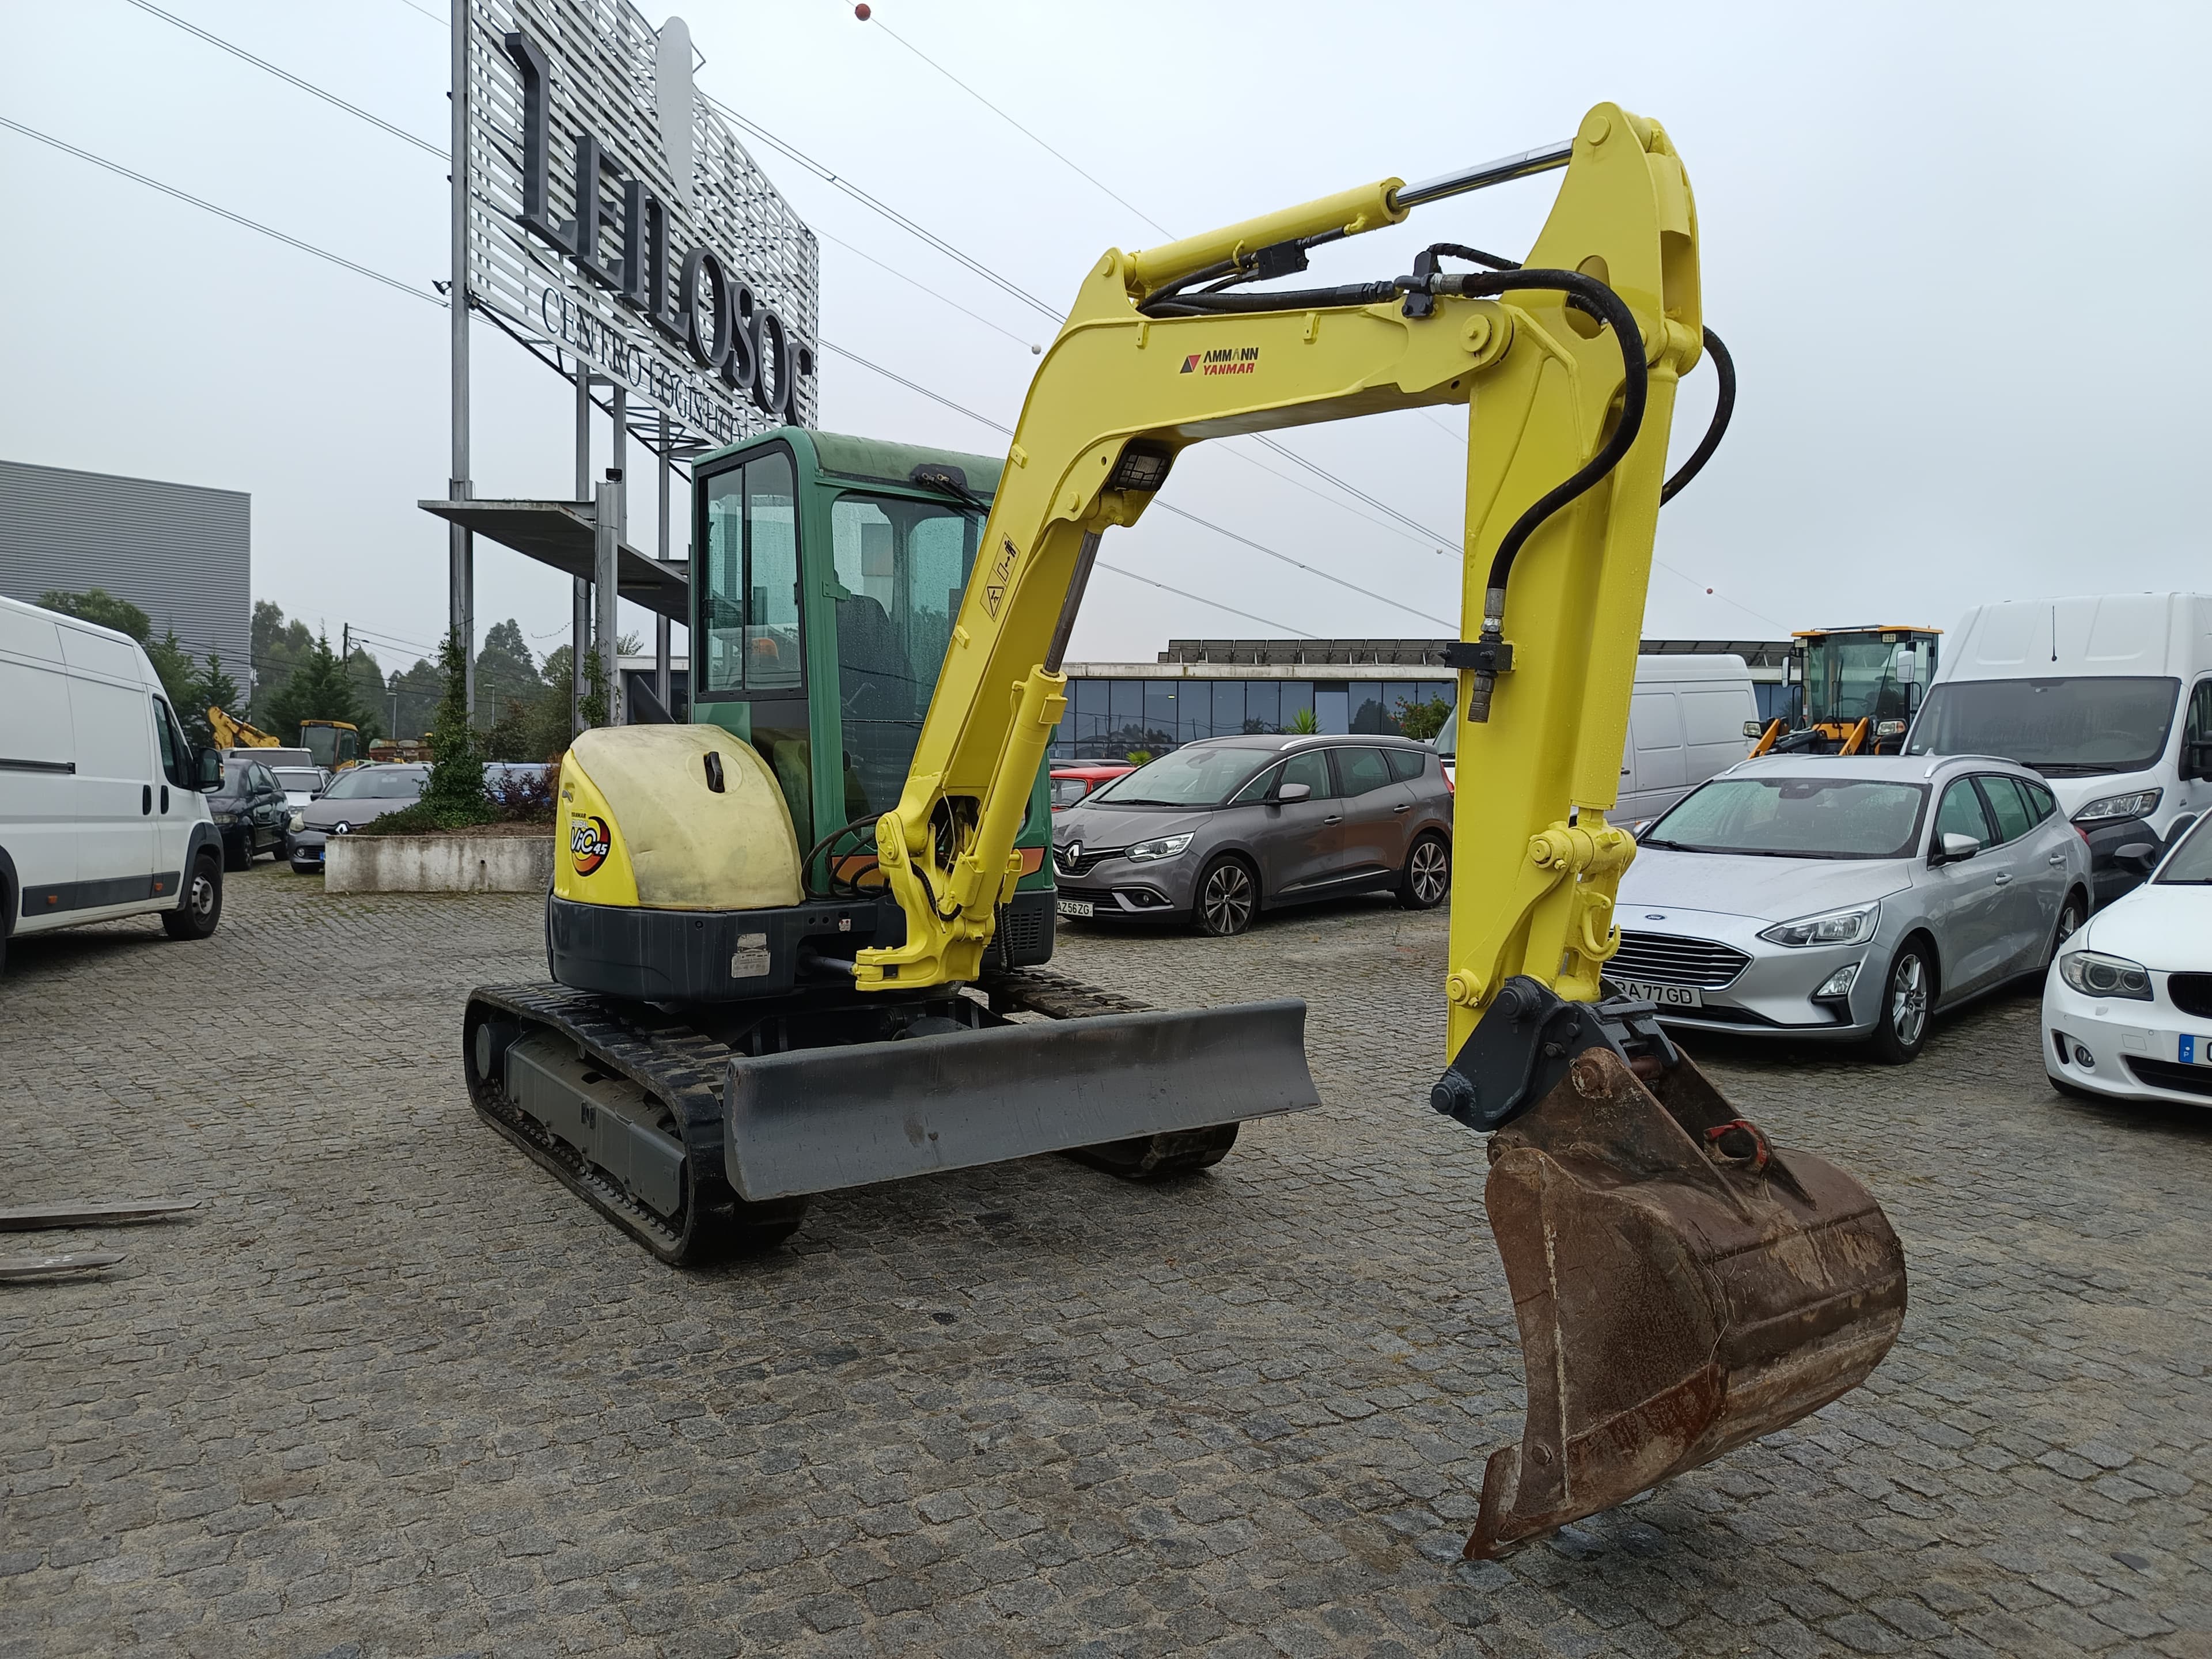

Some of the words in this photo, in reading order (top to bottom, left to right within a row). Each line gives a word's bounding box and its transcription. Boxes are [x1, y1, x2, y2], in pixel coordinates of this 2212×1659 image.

[542, 287, 642, 387] CENTRO
[1203, 347, 1259, 363] AMMANN
[1203, 363, 1255, 376] YANMAR
